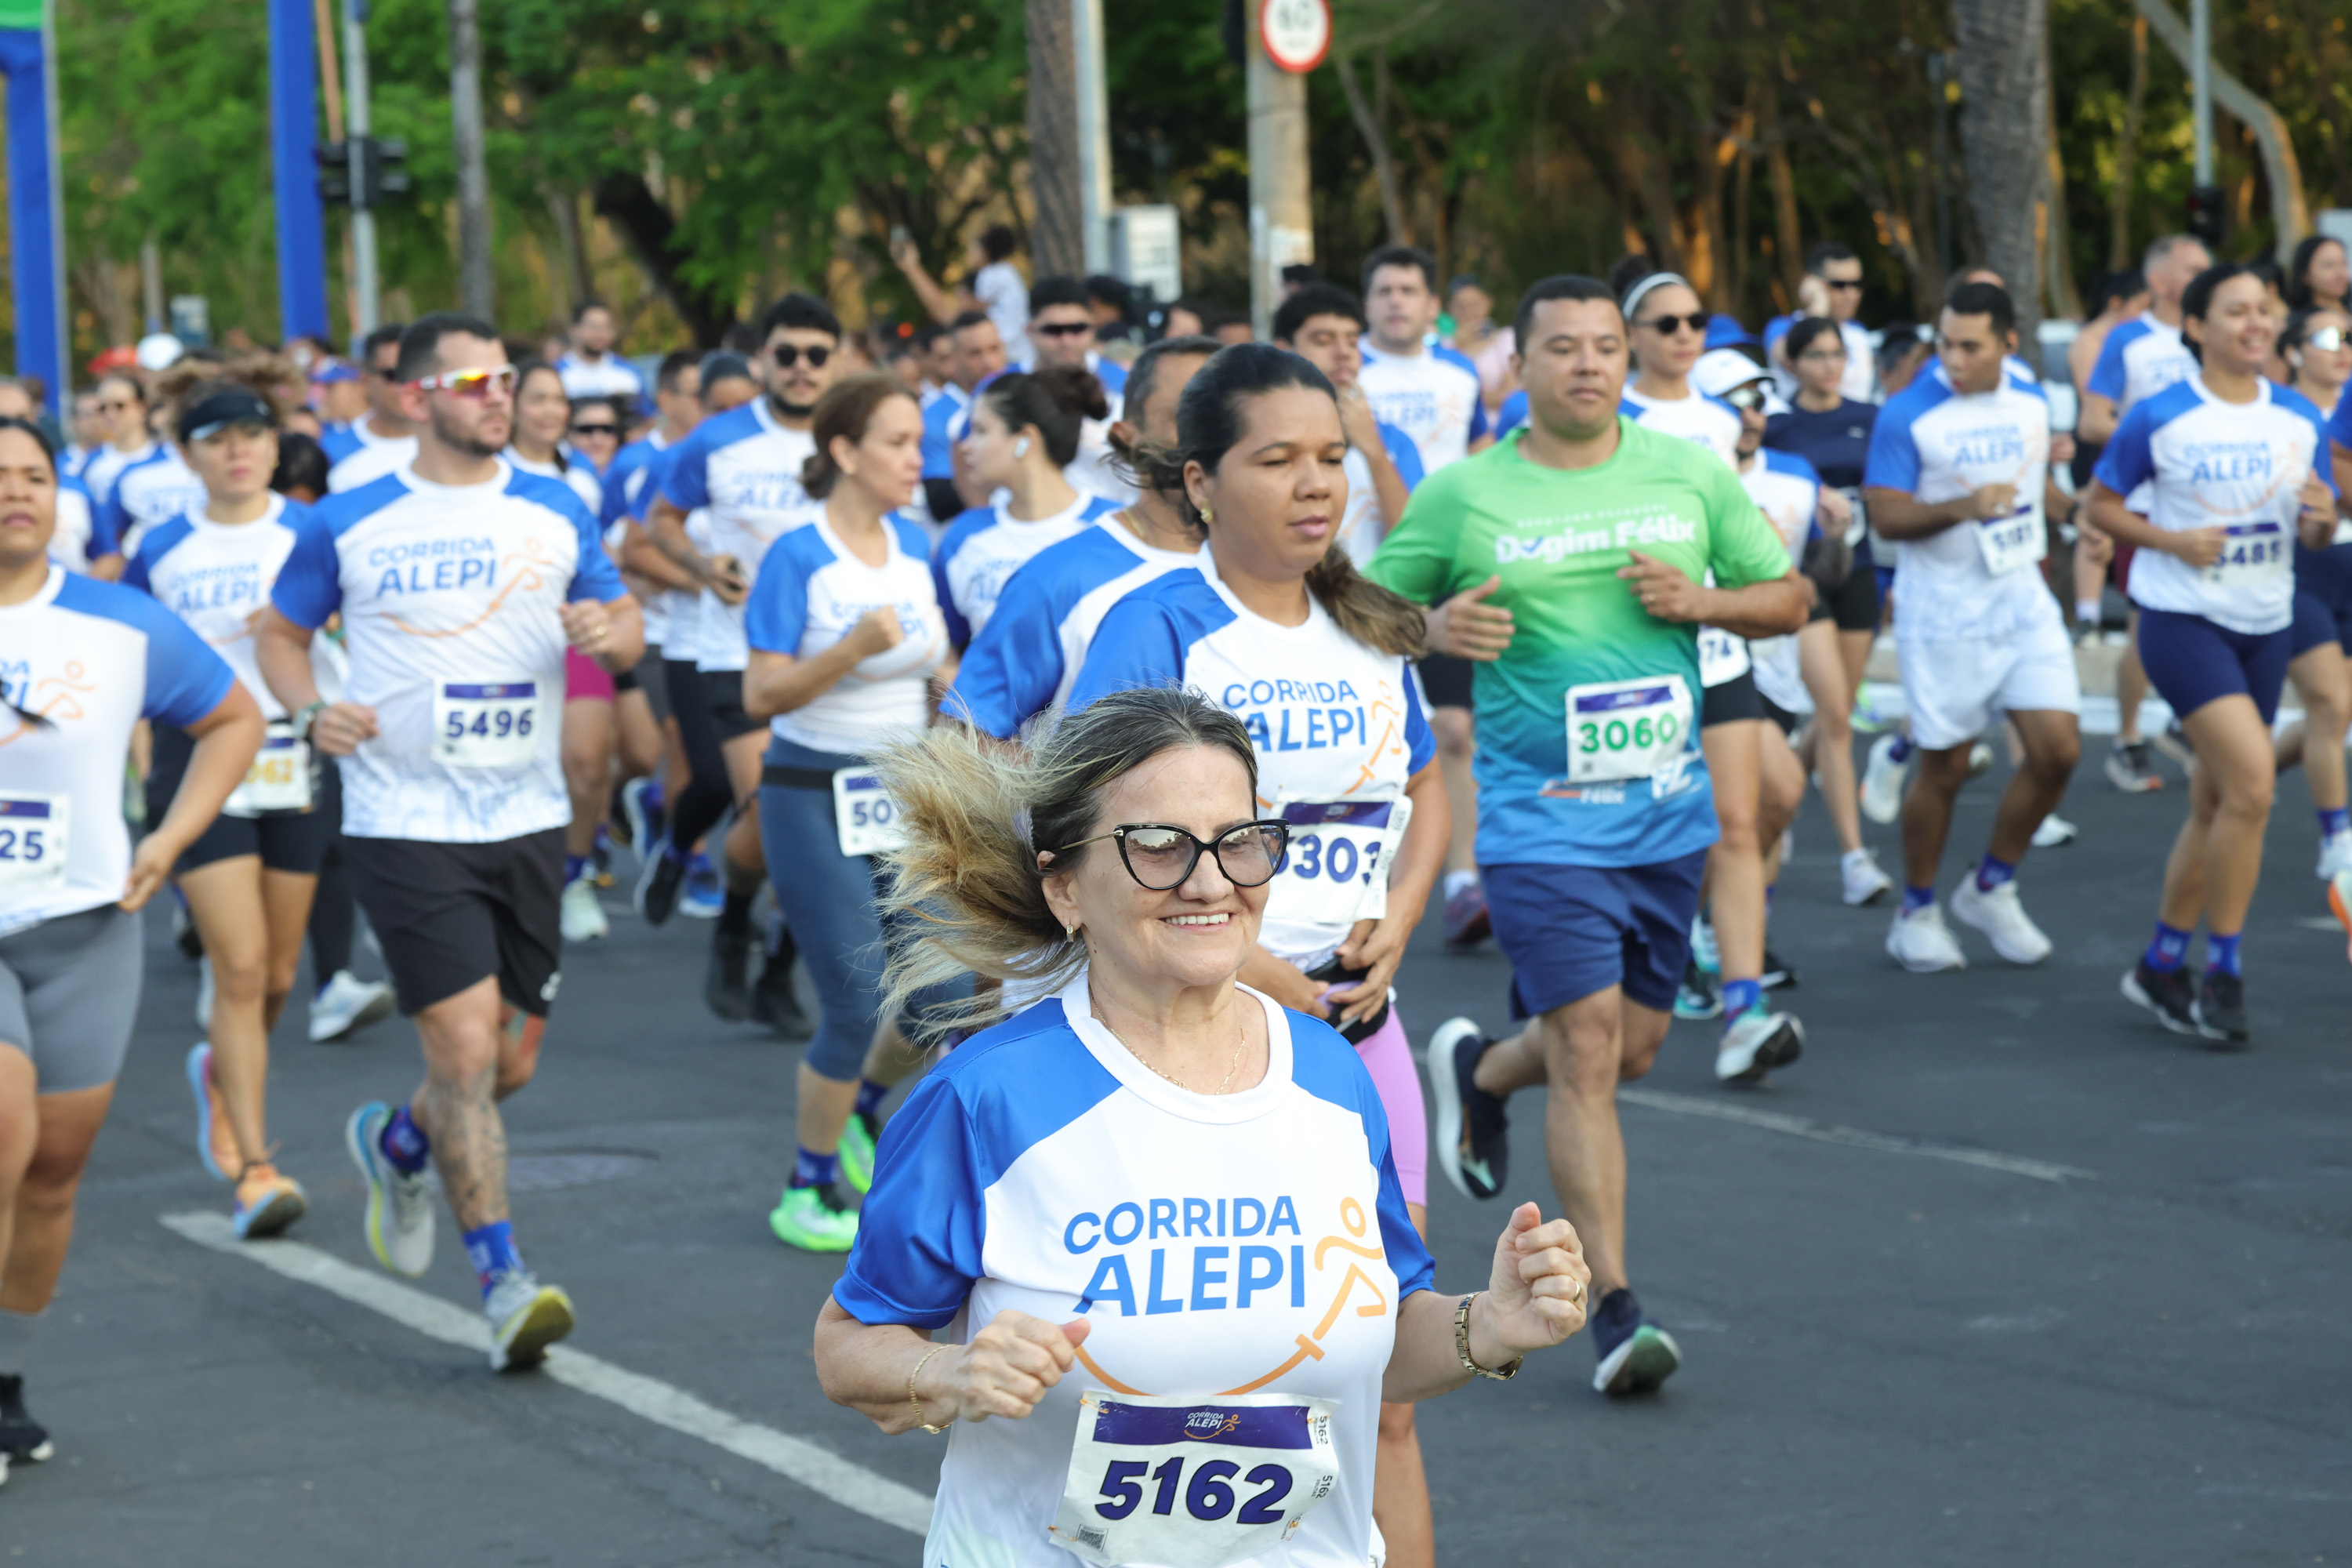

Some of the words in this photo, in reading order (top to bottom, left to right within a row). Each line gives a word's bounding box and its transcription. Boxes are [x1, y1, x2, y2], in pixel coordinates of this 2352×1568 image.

[2191, 458, 2271, 485] ALEPI
[1615, 514, 1697, 548] Félix
[368, 537, 495, 568] CORRIDA
[376, 558, 495, 598] ALEPI
[177, 581, 259, 611] ALEPI
[1223, 679, 1359, 709] CORRIDA
[446, 708, 533, 739] 5496
[1245, 706, 1367, 753] ALEPI
[1580, 712, 1678, 753] 3060
[1064, 1196, 1301, 1254] CORRIDA
[1073, 1245, 1305, 1316] ALEPI
[1185, 1418, 1223, 1429] ALEPI
[1187, 1411, 1224, 1420] CORRIDA
[1319, 1415, 1328, 1445] 5162
[1094, 1457, 1293, 1524] 5162
[1316, 1475, 1333, 1499] 5162
